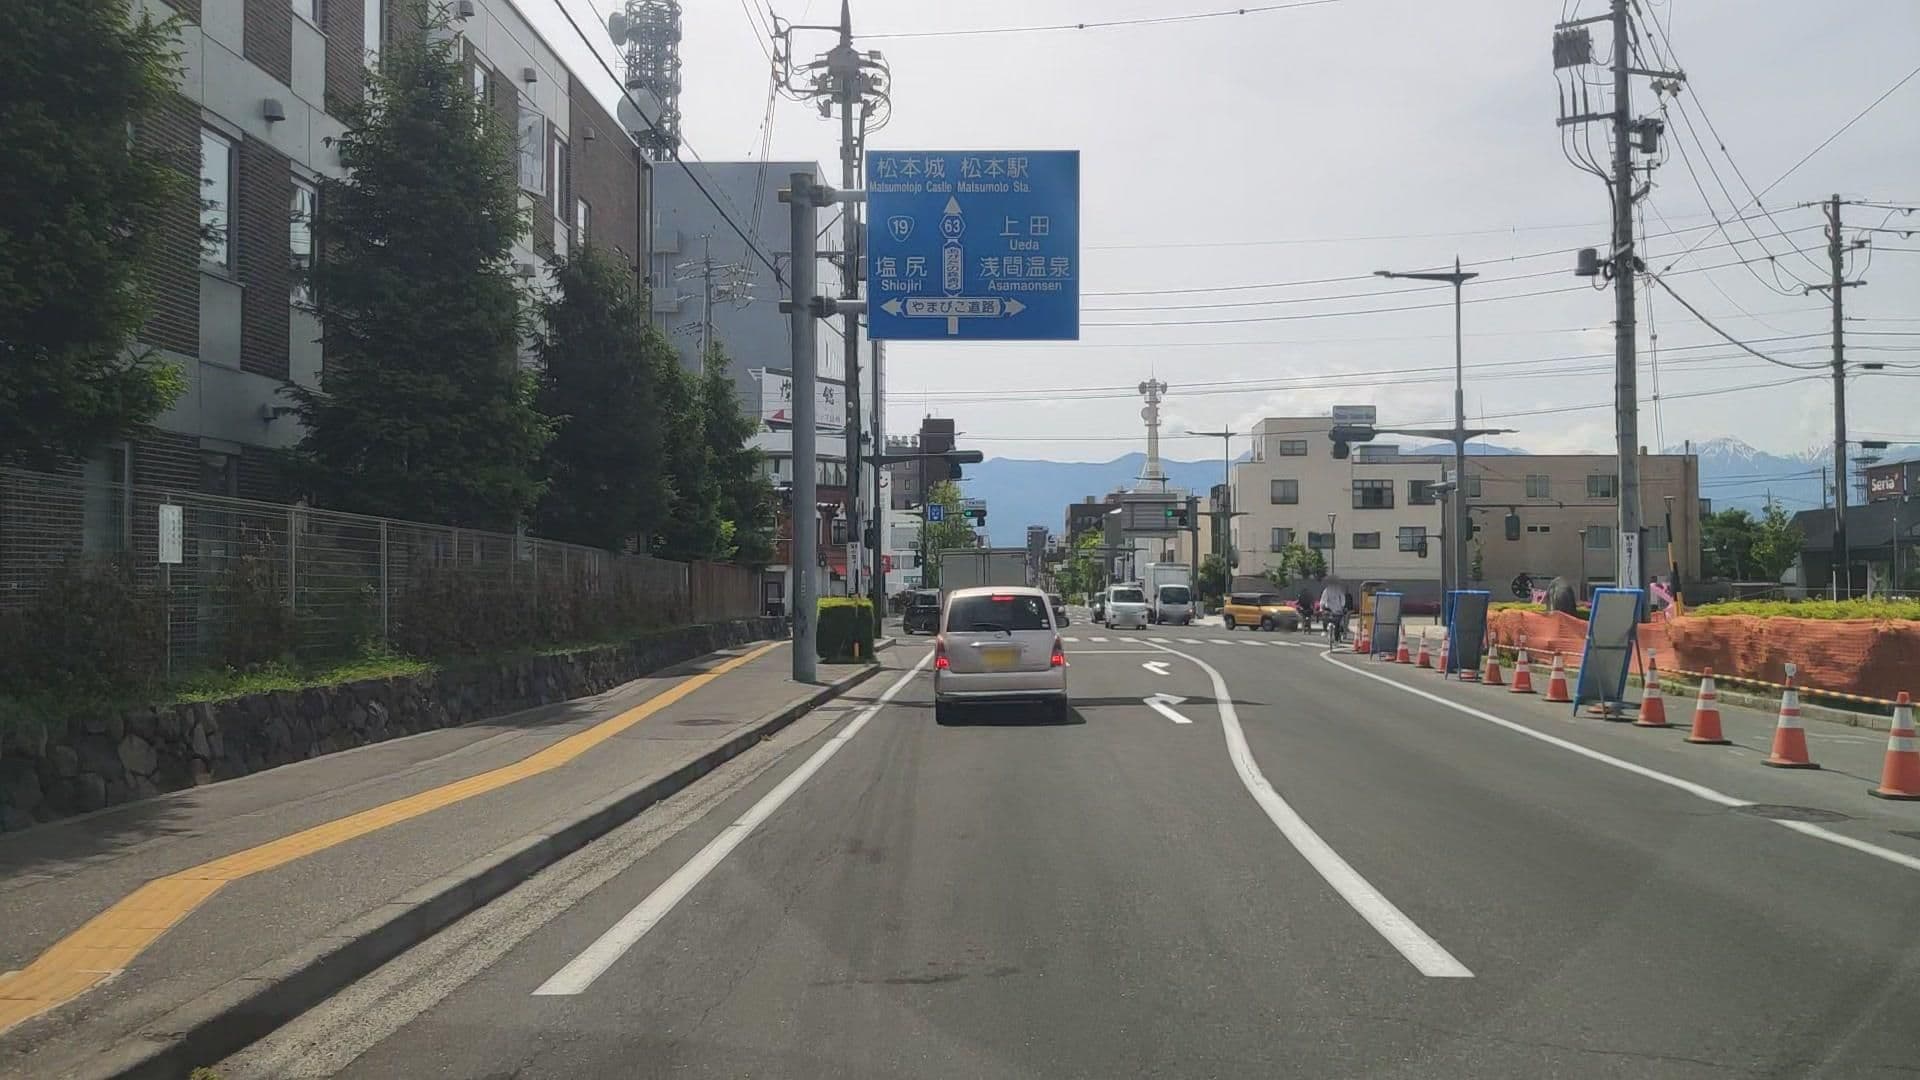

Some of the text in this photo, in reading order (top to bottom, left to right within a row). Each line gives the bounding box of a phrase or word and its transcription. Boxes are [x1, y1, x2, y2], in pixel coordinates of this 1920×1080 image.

[877, 157, 1029, 178] 松本城 松本駅
[870, 181, 1031, 195] Matsumotojo Castle Matsumoto Sta.
[893, 220, 909, 234] 19
[944, 219, 960, 233] 63
[1000, 216, 1049, 236] 上田
[1009, 239, 1040, 251] Ueda
[875, 256, 928, 278] 塩尻
[979, 256, 1071, 278] 浅間温泉
[881, 280, 922, 293] Shiojiri
[987, 280, 1062, 291] Asamaonsen
[911, 300, 995, 314] やまびこ道路
[1871, 476, 1895, 491] Seria
